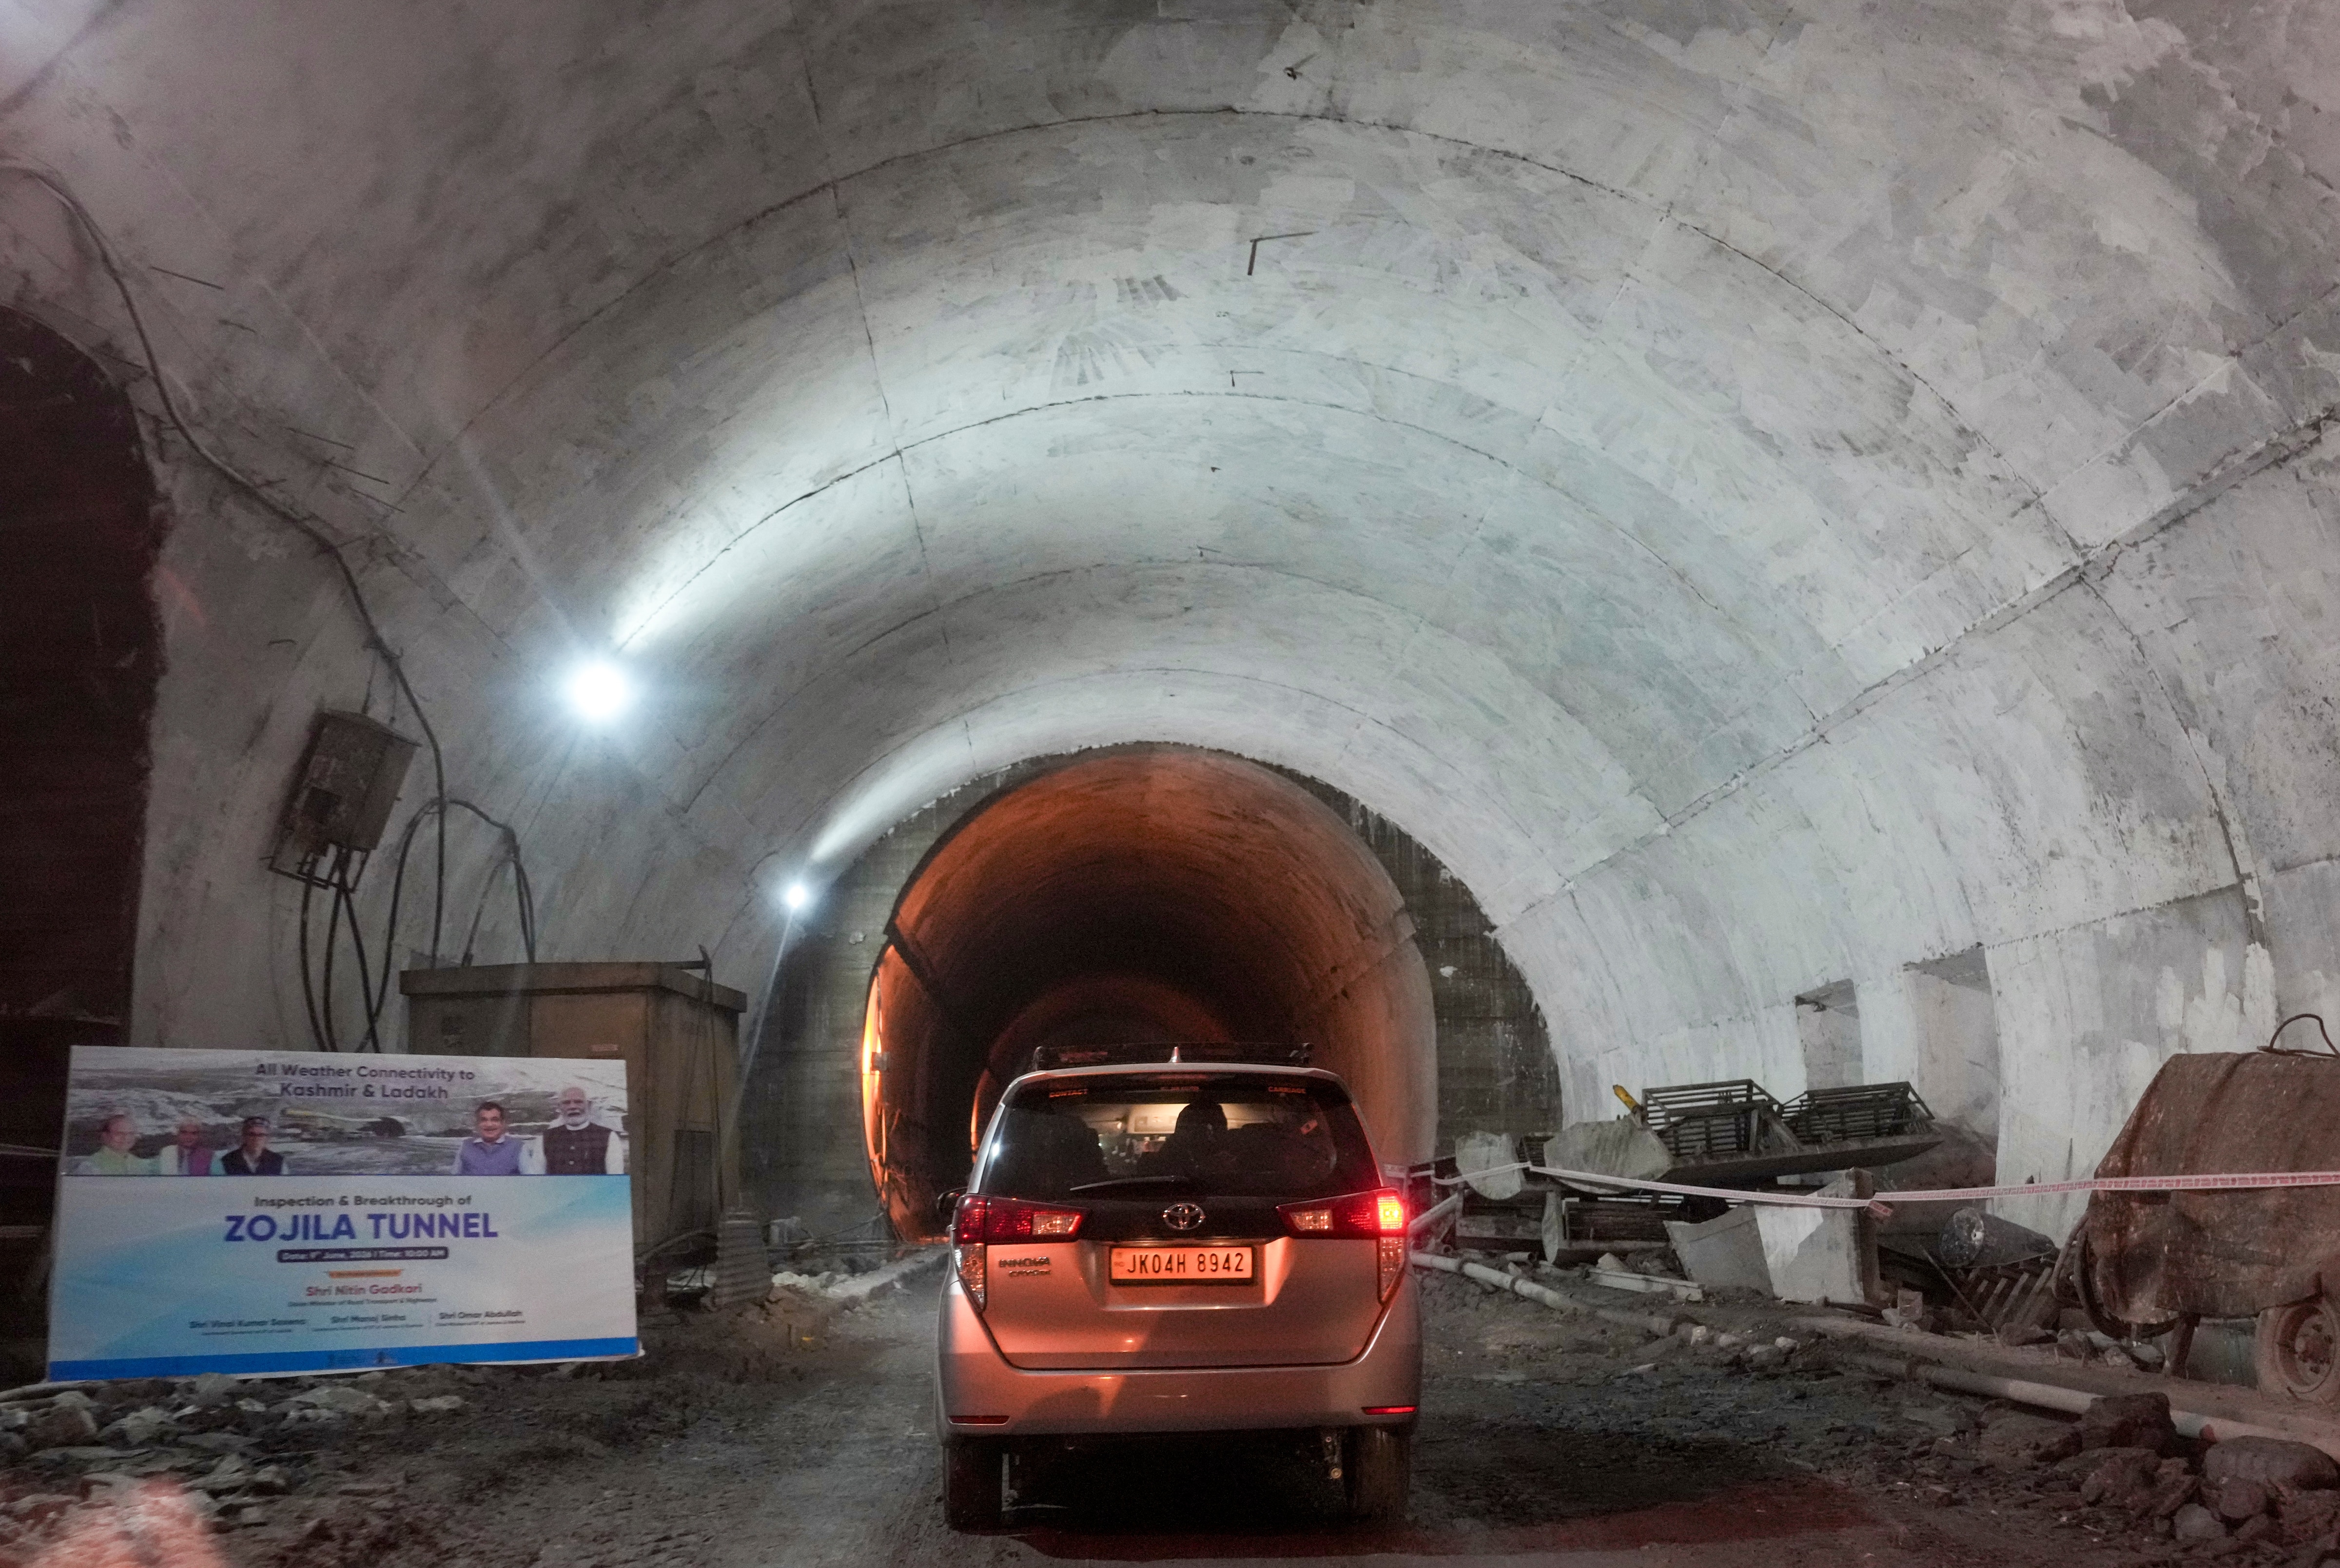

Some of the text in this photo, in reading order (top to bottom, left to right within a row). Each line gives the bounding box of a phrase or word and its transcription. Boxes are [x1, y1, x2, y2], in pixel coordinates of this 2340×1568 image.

[256, 1064, 475, 1082] All Weather Connectivity to
[279, 1082, 448, 1099] Kashmir & Ladakh
[254, 1195, 472, 1209] Inspection & Breakthrough of
[224, 1212, 498, 1242] ZOJILA TUNNEL
[1127, 1252, 1245, 1273] JK04H 8942
[306, 1285, 332, 1297] Shri
[369, 1283, 423, 1295] Gadkari
